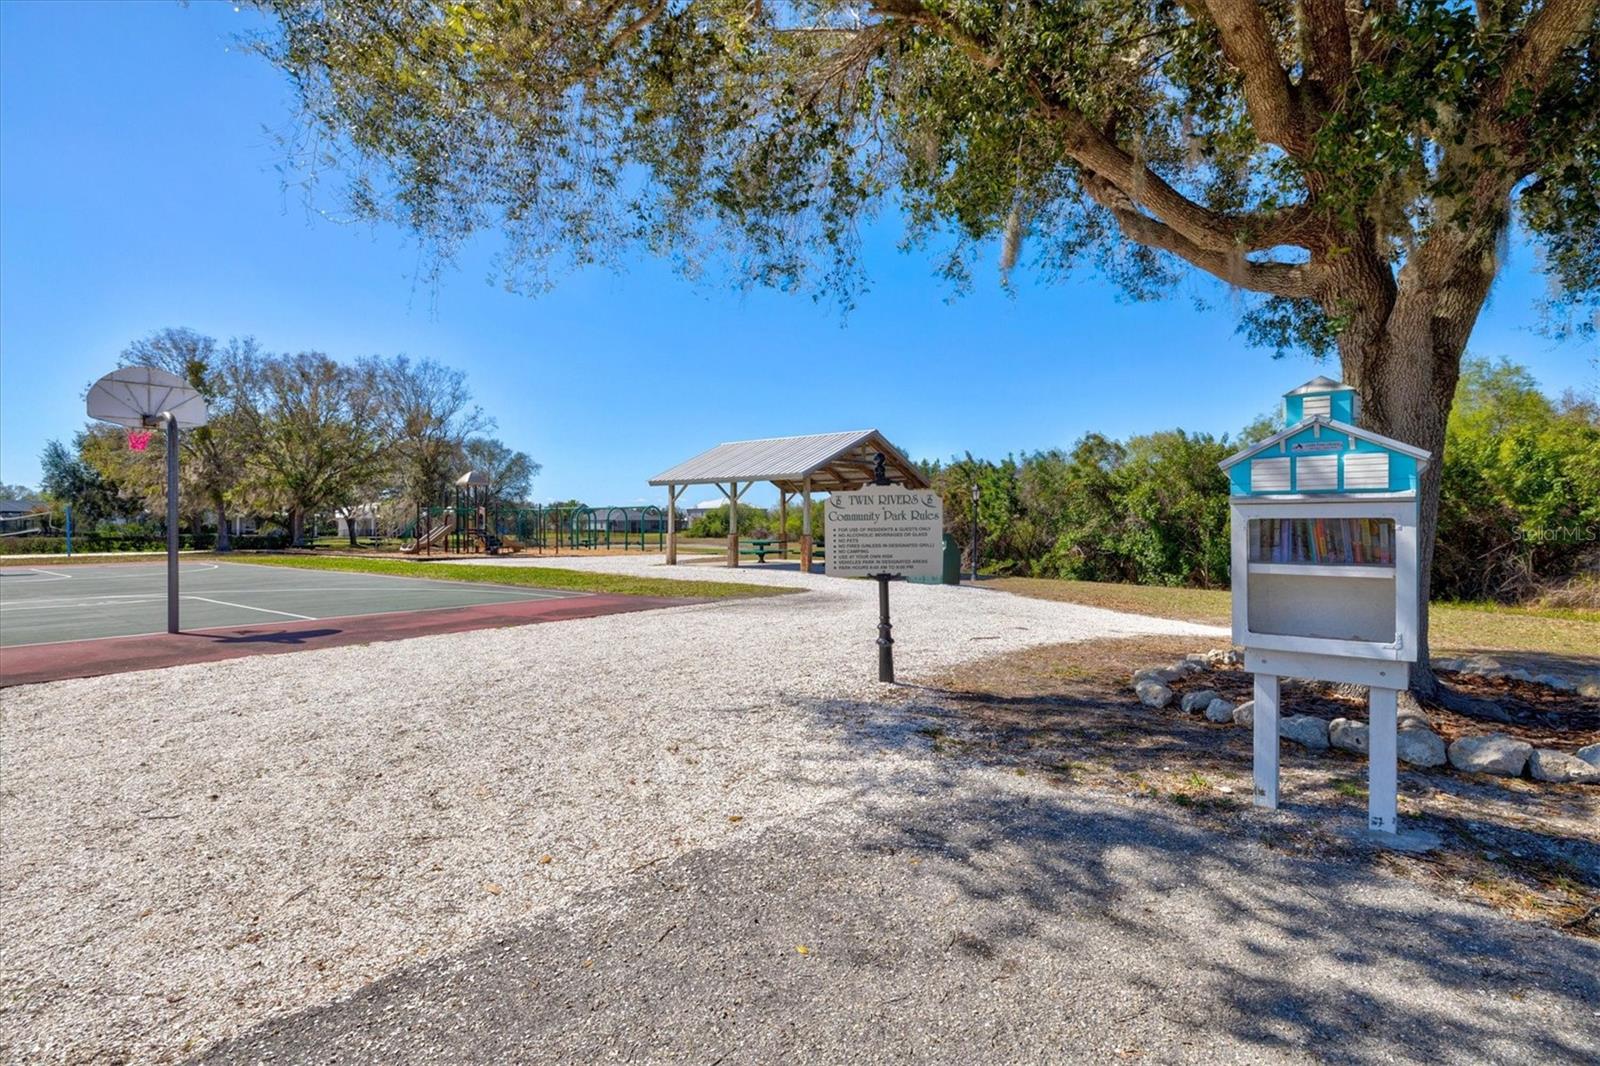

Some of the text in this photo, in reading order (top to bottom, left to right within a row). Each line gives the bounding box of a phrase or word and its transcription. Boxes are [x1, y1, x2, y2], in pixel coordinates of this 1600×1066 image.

[848, 494, 919, 505] TWIN RIVERS
[828, 510, 940, 524] Community Park Rules
